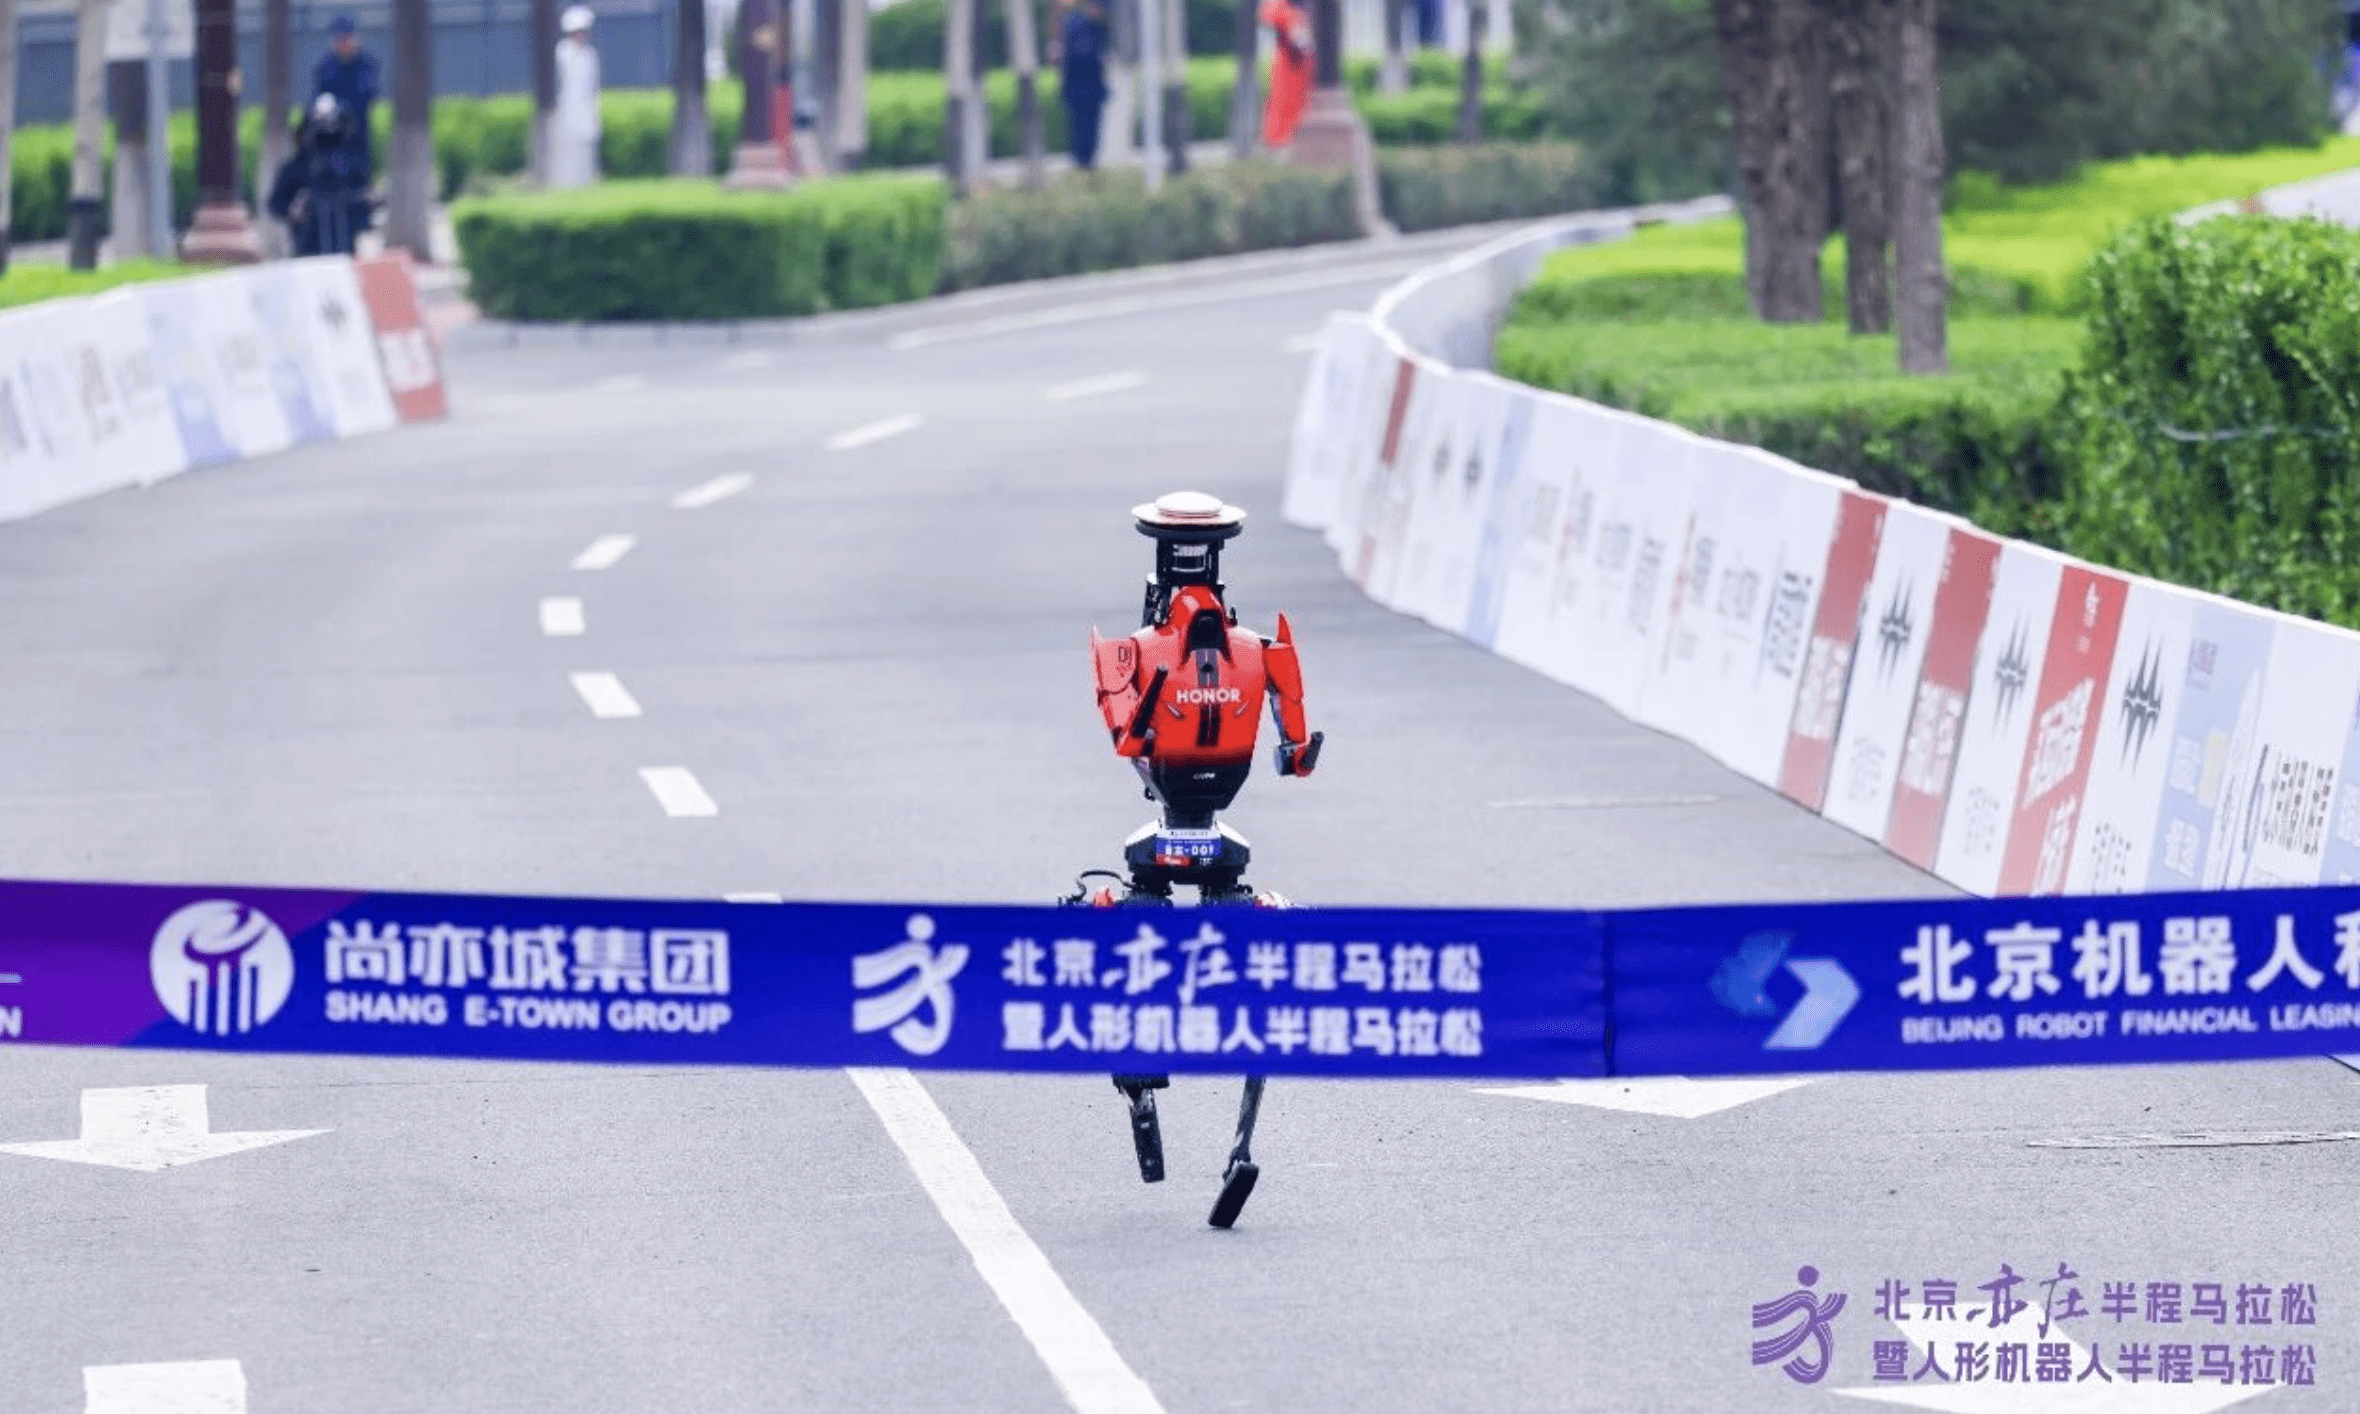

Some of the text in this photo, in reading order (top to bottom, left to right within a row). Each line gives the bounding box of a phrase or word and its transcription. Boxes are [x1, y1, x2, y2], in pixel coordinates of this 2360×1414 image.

[1176, 688, 1241, 704] HONOR
[325, 919, 731, 996] 尚亦城集团
[1001, 921, 1483, 1005] 北京亦庄半程马拉松
[325, 990, 732, 1033] SHANG E-TOWN GROUP
[1002, 1001, 1484, 1057] 暨人形机器人半程马拉松
[1902, 1013, 2004, 1043] BEIJING
[2016, 1009, 2109, 1040] ROBOT
[2121, 1004, 2259, 1036] FINANCIAL
